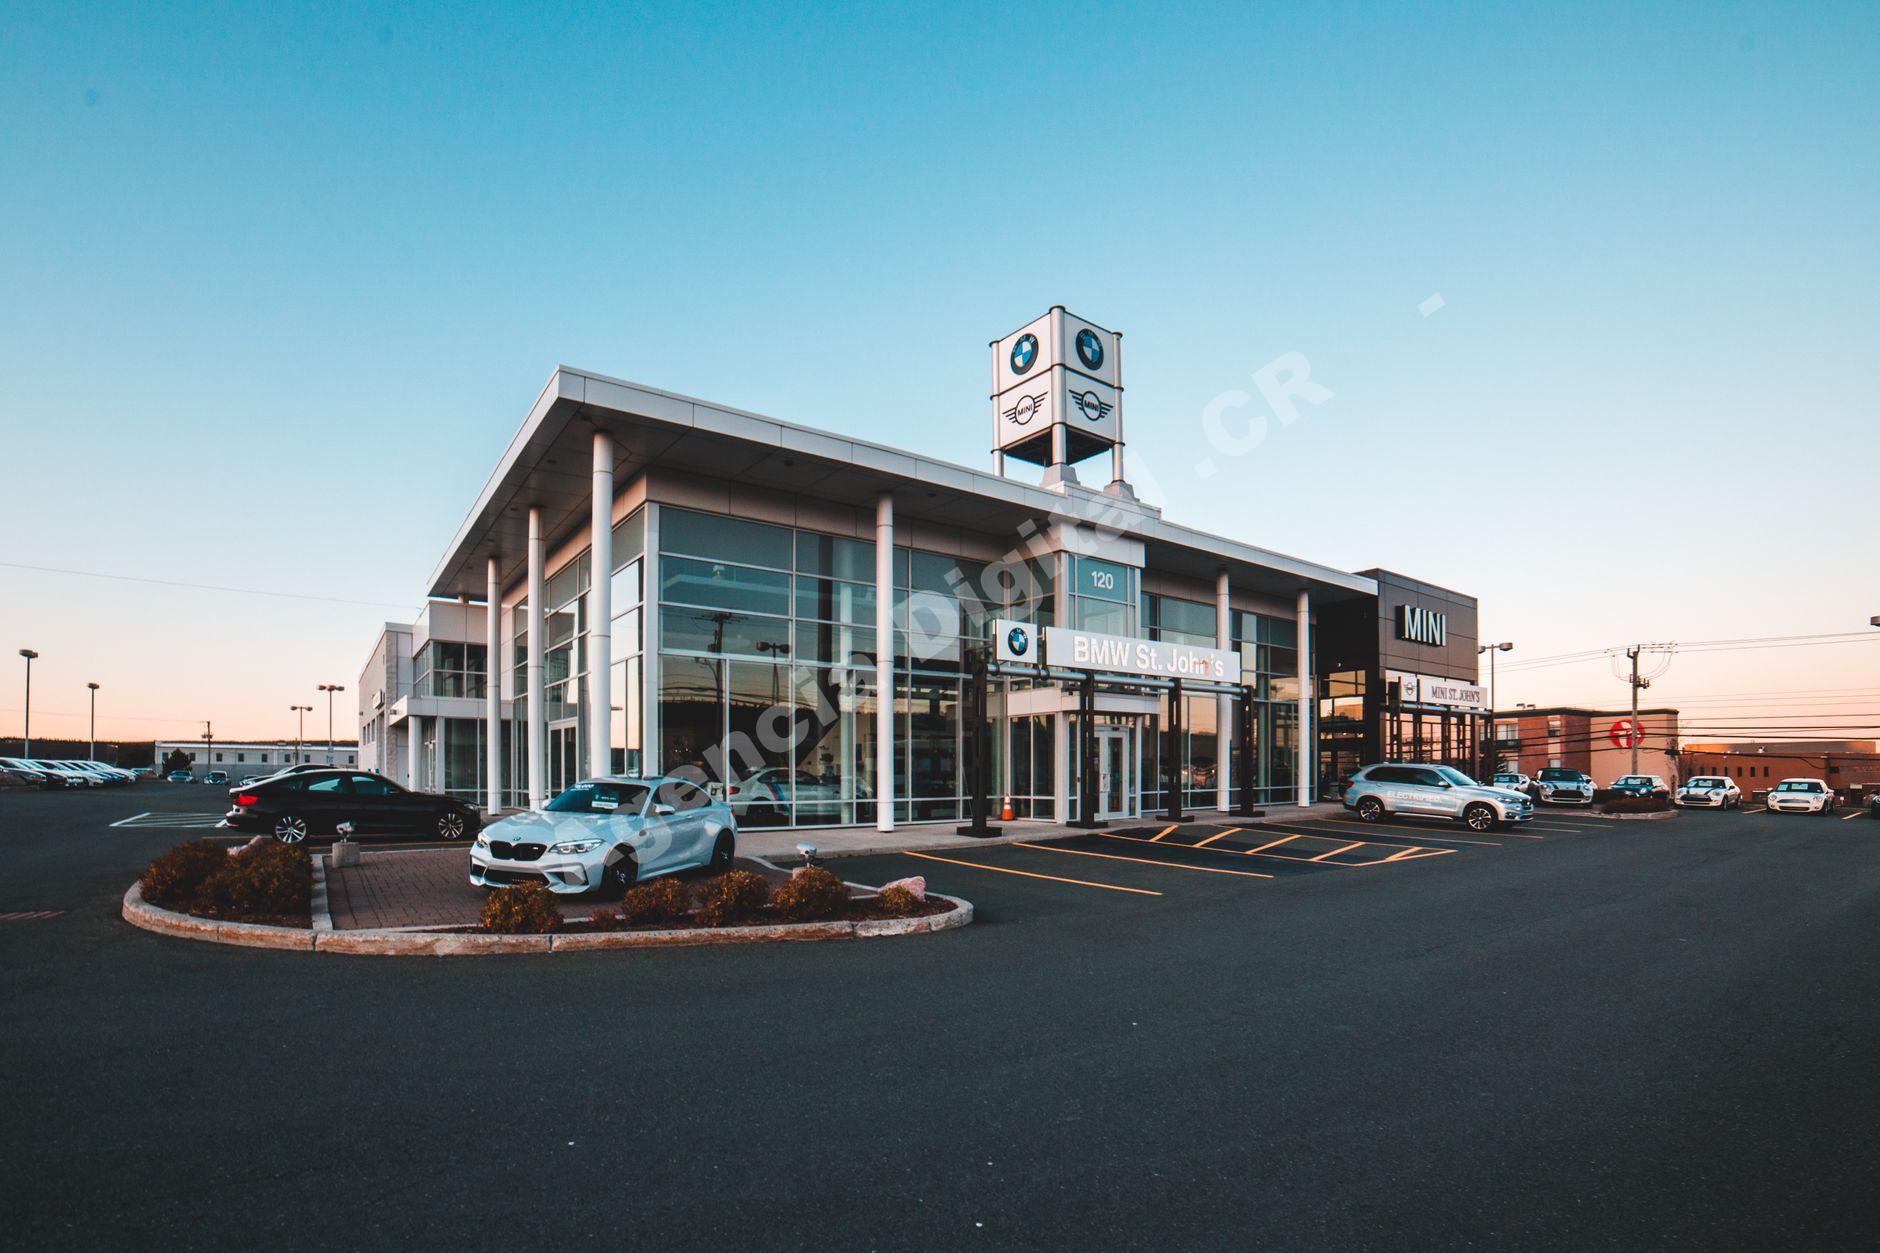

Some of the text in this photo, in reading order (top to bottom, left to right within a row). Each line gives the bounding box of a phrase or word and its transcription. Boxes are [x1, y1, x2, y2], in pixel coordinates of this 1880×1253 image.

[1017, 405, 1033, 416] MINI
[1083, 399, 1099, 412] MINI
[1091, 571, 1114, 589] 120
[1402, 604, 1446, 646] MINI
[1073, 635, 1224, 677] BMW St. John's
[1431, 685, 1447, 699] MINI
[1448, 687, 1458, 700] ST.
[1459, 689, 1480, 703] JOHN'S
